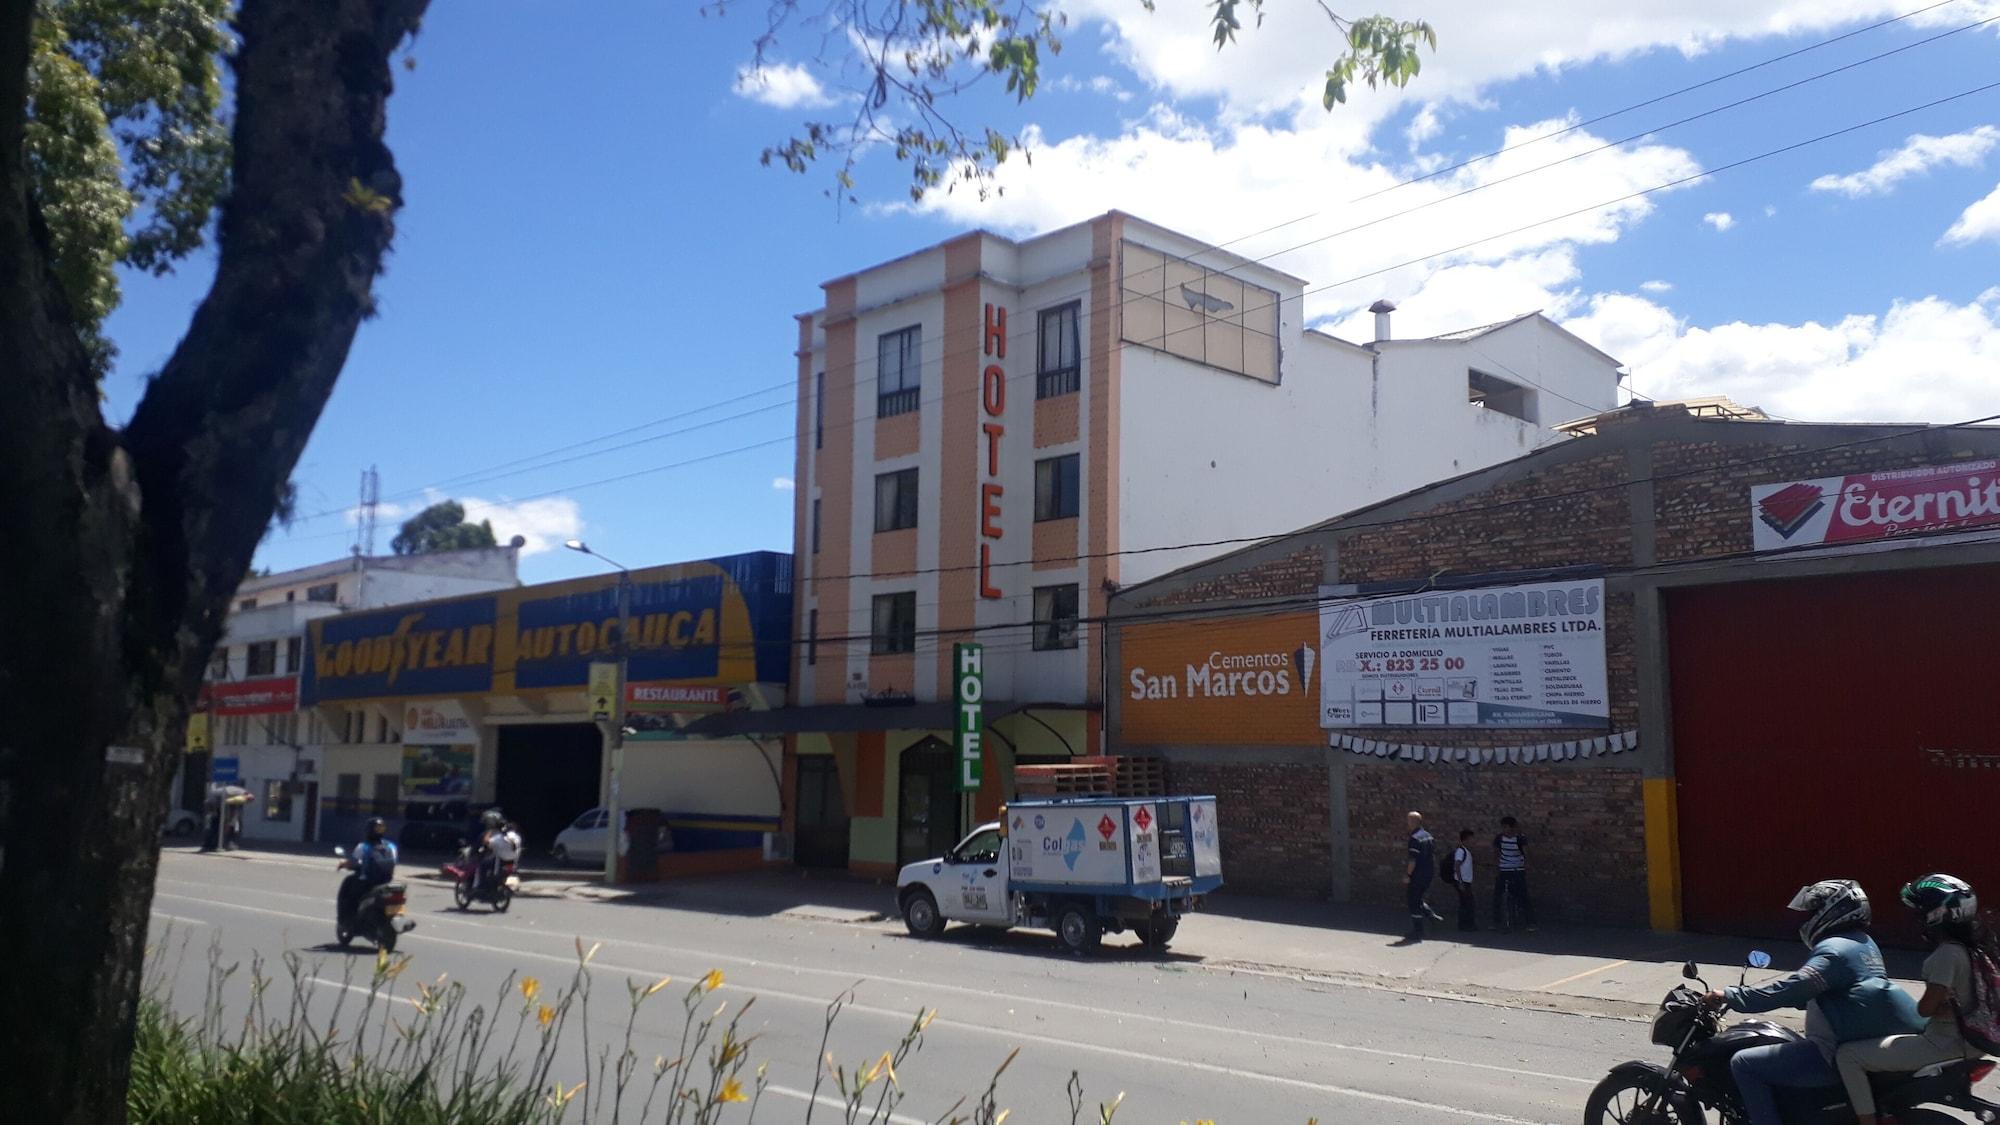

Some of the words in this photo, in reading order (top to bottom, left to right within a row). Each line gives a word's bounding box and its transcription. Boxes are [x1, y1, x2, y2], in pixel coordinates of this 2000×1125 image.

[981, 302, 1007, 600] HOTEL
[1872, 468, 1935, 481] DISTRIBUIDOR
[1937, 461, 1996, 475] AUTORIZADO
[1840, 476, 2000, 527] Eternit
[1372, 586, 1600, 626] MULTIALAMBRES
[517, 608, 715, 660] AUTOCAUCA
[1371, 625, 1440, 641] FERRETERÍA
[1445, 621, 1557, 638] MULTIALAMBRES
[1562, 619, 1601, 633] LTDA.
[1209, 651, 1288, 670] Cementos
[1355, 651, 1390, 660] SERVICIO
[1393, 651, 1399, 659] A
[1400, 649, 1443, 659] DOMICILIO
[1386, 658, 1415, 672] 823
[1420, 657, 1440, 671] 25
[1444, 656, 1465, 670] 00
[633, 687, 719, 703] RESTAURANTE
[1130, 667, 1177, 701] San
[1186, 663, 1290, 698] Marcos
[961, 648, 982, 787] HOTEL
